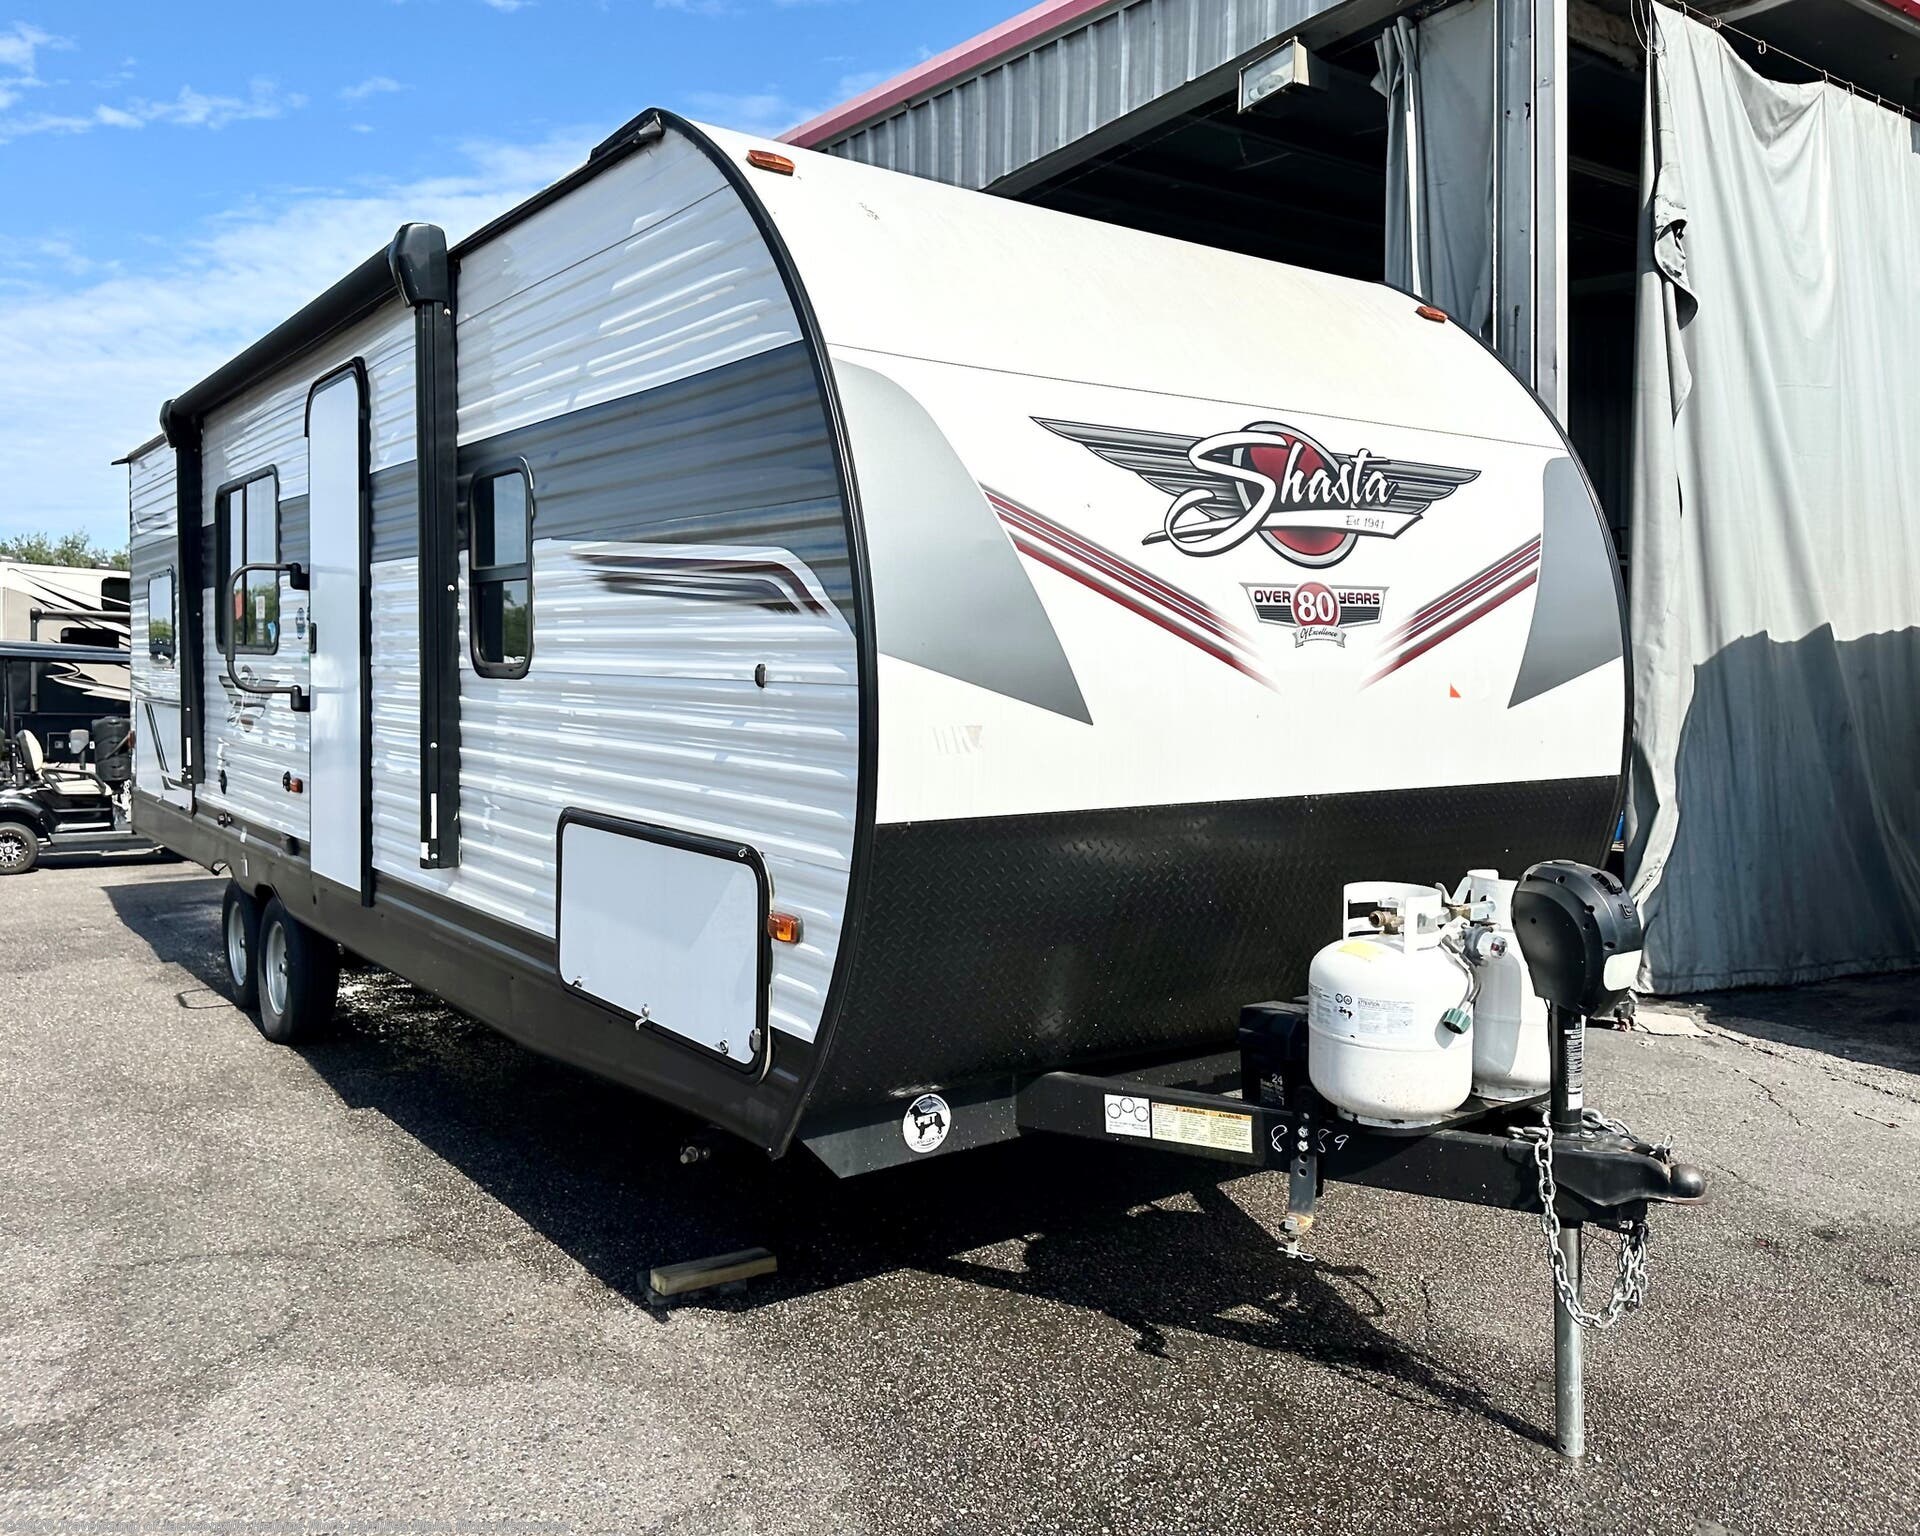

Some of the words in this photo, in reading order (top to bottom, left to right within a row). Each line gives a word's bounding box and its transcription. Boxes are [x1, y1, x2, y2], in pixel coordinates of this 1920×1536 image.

[1164, 431, 1399, 557] Shasta
[1364, 517, 1385, 530] 1941
[1254, 590, 1291, 603] OVER
[1297, 591, 1335, 622] 80
[1338, 592, 1380, 605] YEARS
[1308, 627, 1338, 638] Excellence
[1271, 1073, 1283, 1085] 24
